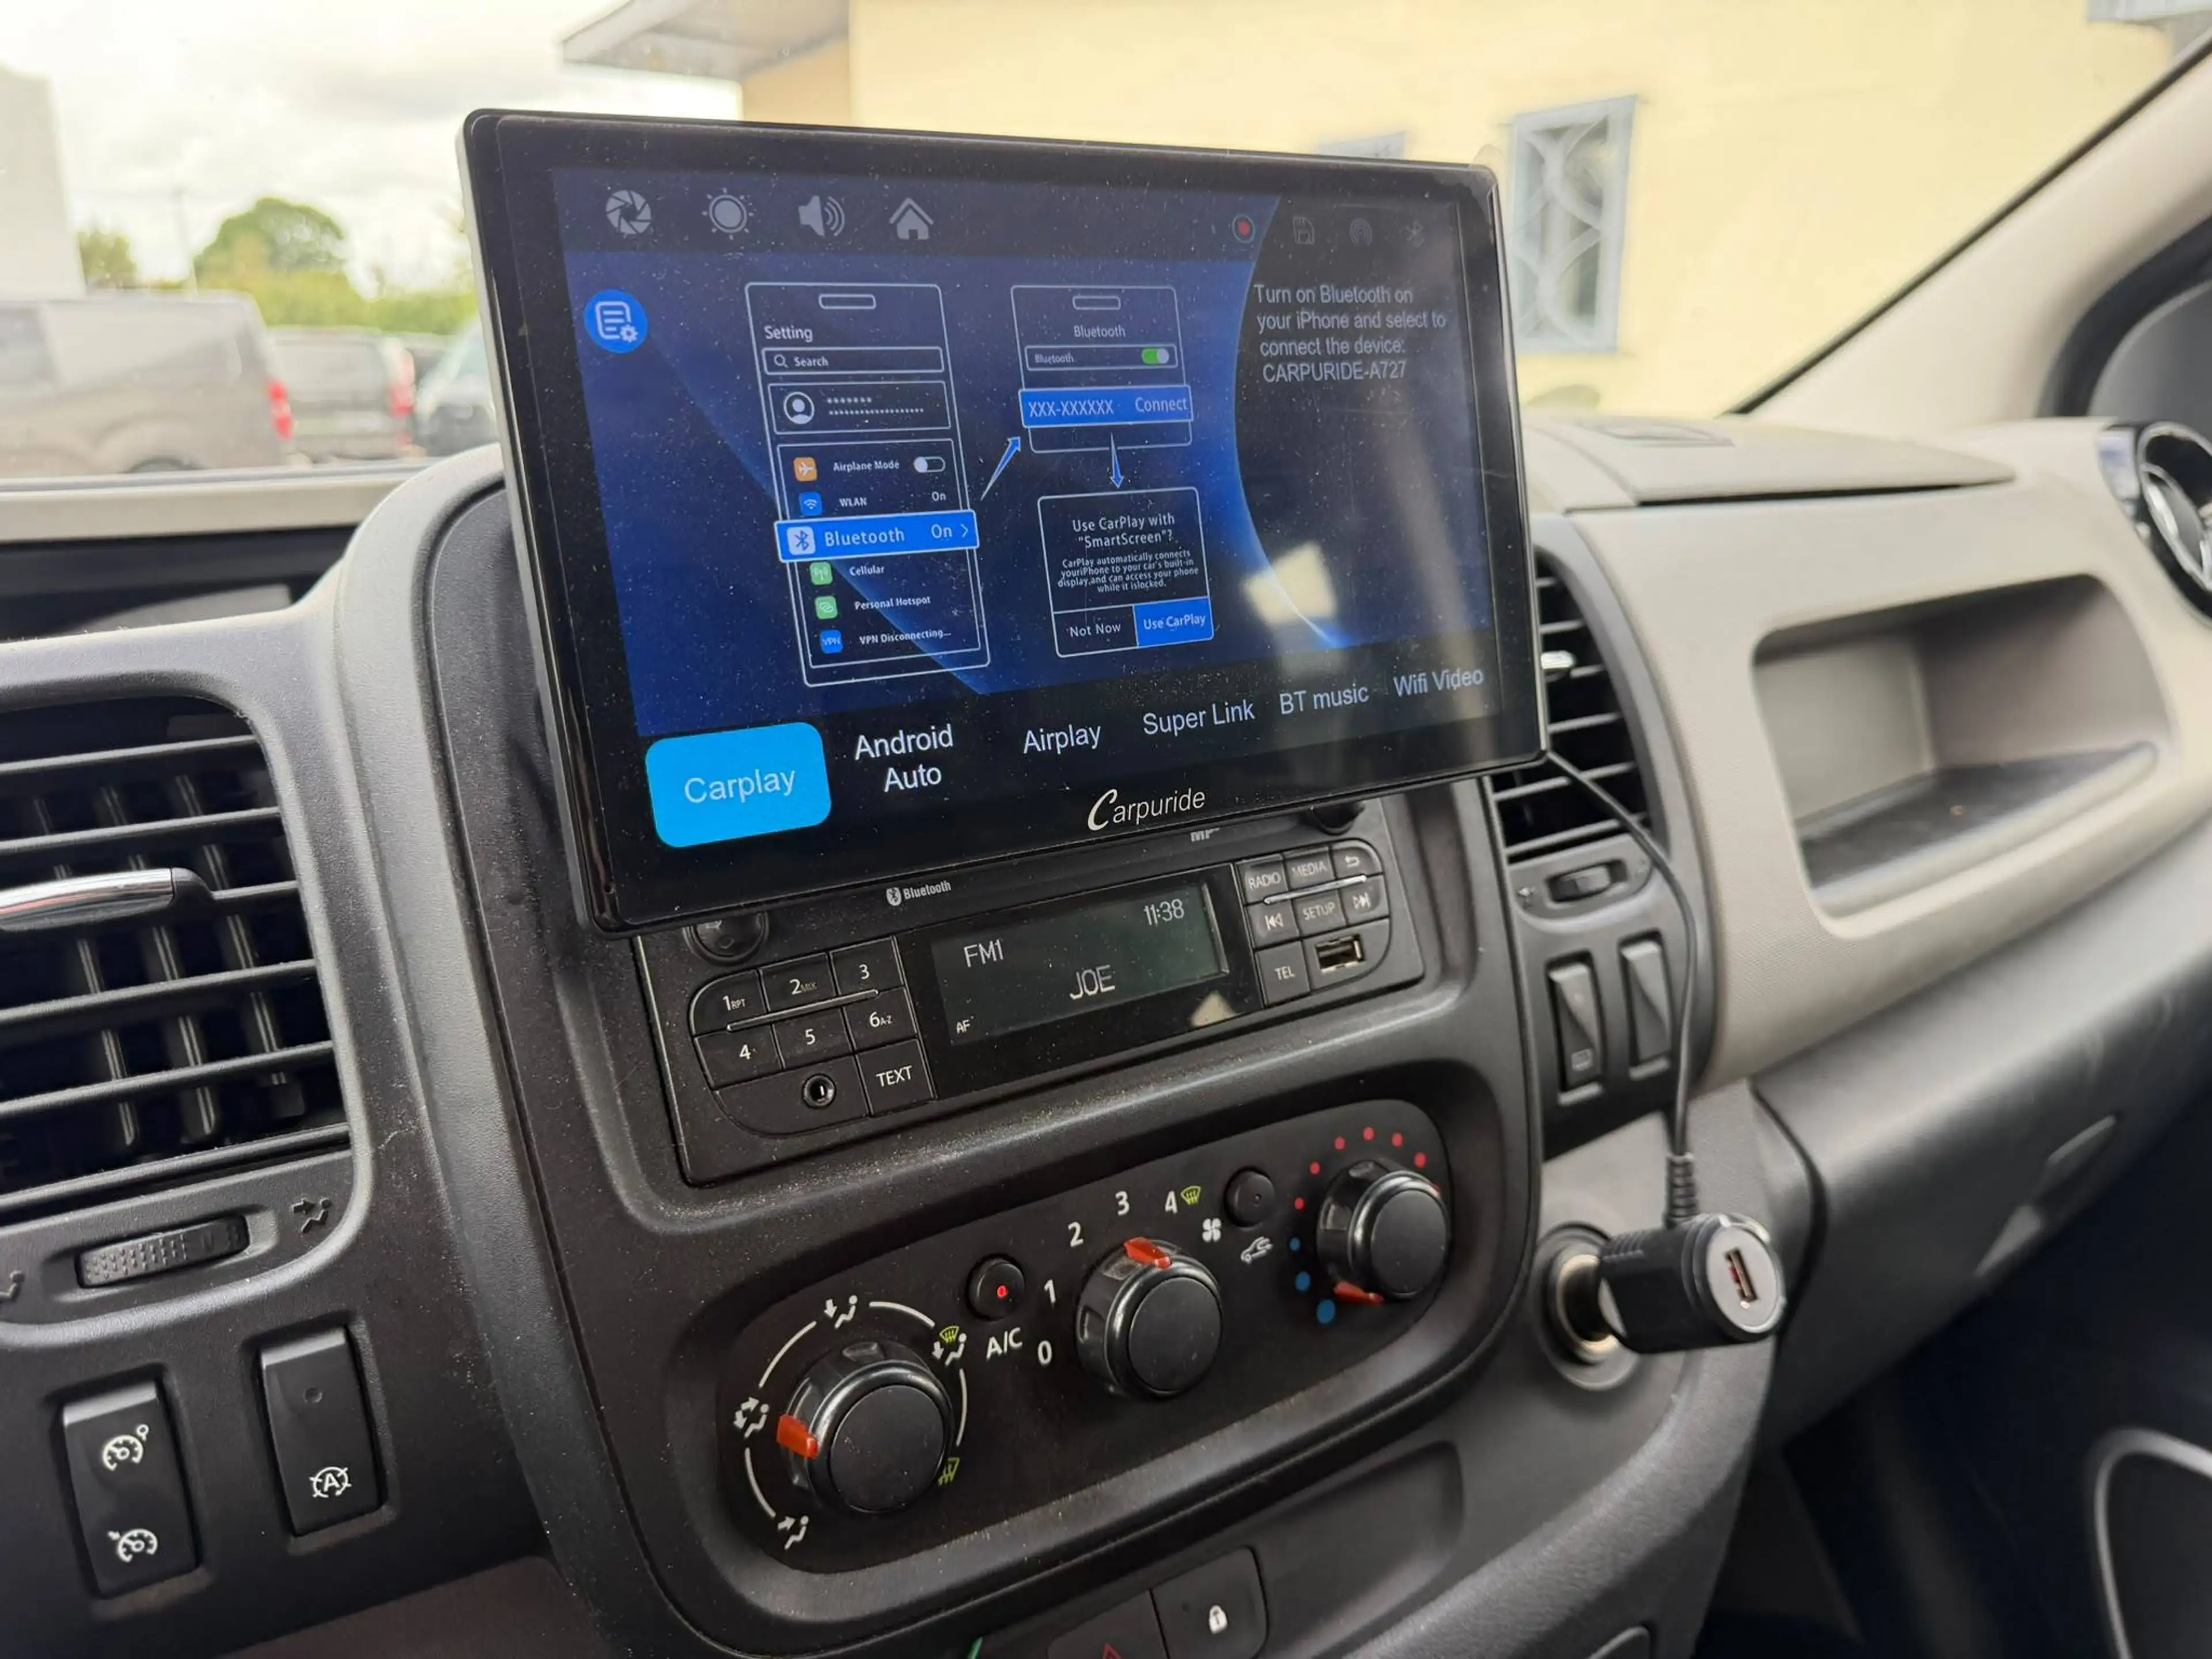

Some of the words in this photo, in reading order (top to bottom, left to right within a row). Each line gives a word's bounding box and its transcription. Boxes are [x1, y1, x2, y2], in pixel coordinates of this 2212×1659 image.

[1253, 284, 1291, 304] Turn
[1296, 289, 1316, 304] on
[1320, 285, 1391, 304] Bluetooth
[1394, 289, 1414, 304] on
[1073, 324, 1126, 339] Bluetooth
[1256, 315, 1291, 335] your
[1296, 310, 1349, 329] iPhone
[1354, 311, 1381, 328] and
[1385, 310, 1428, 329] select
[1431, 310, 1446, 328] to
[764, 325, 813, 342] Setting
[1260, 338, 1322, 357] connect
[1326, 336, 1349, 355] the
[1354, 335, 1406, 355] device:
[794, 356, 829, 367] Search
[1035, 352, 1074, 364] Bluetooth
[1263, 360, 1407, 383] CARPURIDE-A727
[1028, 400, 1114, 418] XXX-XXXXXX
[1135, 397, 1187, 413] Connect
[833, 461, 872, 472] Airplane
[874, 460, 899, 469] Mode
[839, 498, 868, 507] WLAN
[931, 491, 946, 502] On
[1072, 520, 1095, 532] Use
[1099, 516, 1145, 531] CarPlay
[1148, 513, 1175, 525] with
[824, 527, 905, 547] Bluetooth
[931, 524, 953, 539] On
[1078, 529, 1173, 548] "SmartScreen"?
[1062, 559, 1094, 569] CarPlay
[1096, 552, 1153, 565] automatically
[1154, 549, 1191, 560] connects
[1111, 564, 1121, 573] to
[1123, 562, 1141, 574] your
[1143, 560, 1162, 570] car's
[1164, 558, 1194, 568] built-in
[849, 565, 885, 576] Cellular
[1109, 574, 1123, 584] can
[1125, 573, 1152, 582] access
[1153, 570, 1172, 581] your
[1173, 567, 1199, 578] phone
[1097, 582, 1120, 593] while
[1122, 582, 1129, 590] it
[854, 599, 893, 611] Personal
[896, 596, 931, 608] Hotspot
[1070, 626, 1092, 638] Not
[1096, 623, 1121, 634] Now
[1143, 618, 1163, 630] Use
[1165, 614, 1206, 628] CarPlay
[822, 637, 840, 646] VPN
[859, 635, 878, 645] VPN
[1393, 672, 1427, 697] Wifi
[1431, 668, 1484, 691] Video
[1279, 690, 1307, 715] BT
[1313, 683, 1370, 710] music
[1143, 710, 1207, 737] Super
[1212, 699, 1255, 725] Link
[854, 724, 953, 760] Android
[1023, 725, 1101, 755] Airplay
[684, 768, 796, 804] Carplay
[883, 764, 942, 793] Auto
[1087, 787, 1206, 831] Carpuride
[1291, 861, 1327, 877] MEDIA
[903, 880, 952, 899] Bluetooth
[1248, 872, 1282, 890] RADIO
[1143, 898, 1185, 926] 11:38
[1302, 902, 1336, 921] SETUP
[963, 939, 1004, 968] FM1
[859, 964, 870, 979] 3
[1274, 964, 1296, 981] TEL
[1069, 964, 1116, 1000] JOE
[956, 1019, 970, 1034] AF
[805, 1028, 816, 1045] 5
[739, 1044, 751, 1060] 4
[876, 1065, 912, 1088] TEXT
[1115, 1191, 1130, 1216] 3
[1164, 1190, 1179, 1214] 4
[1067, 1222, 1085, 1248] 2
[1043, 1279, 1056, 1304] 1
[985, 1327, 1023, 1360] A/C
